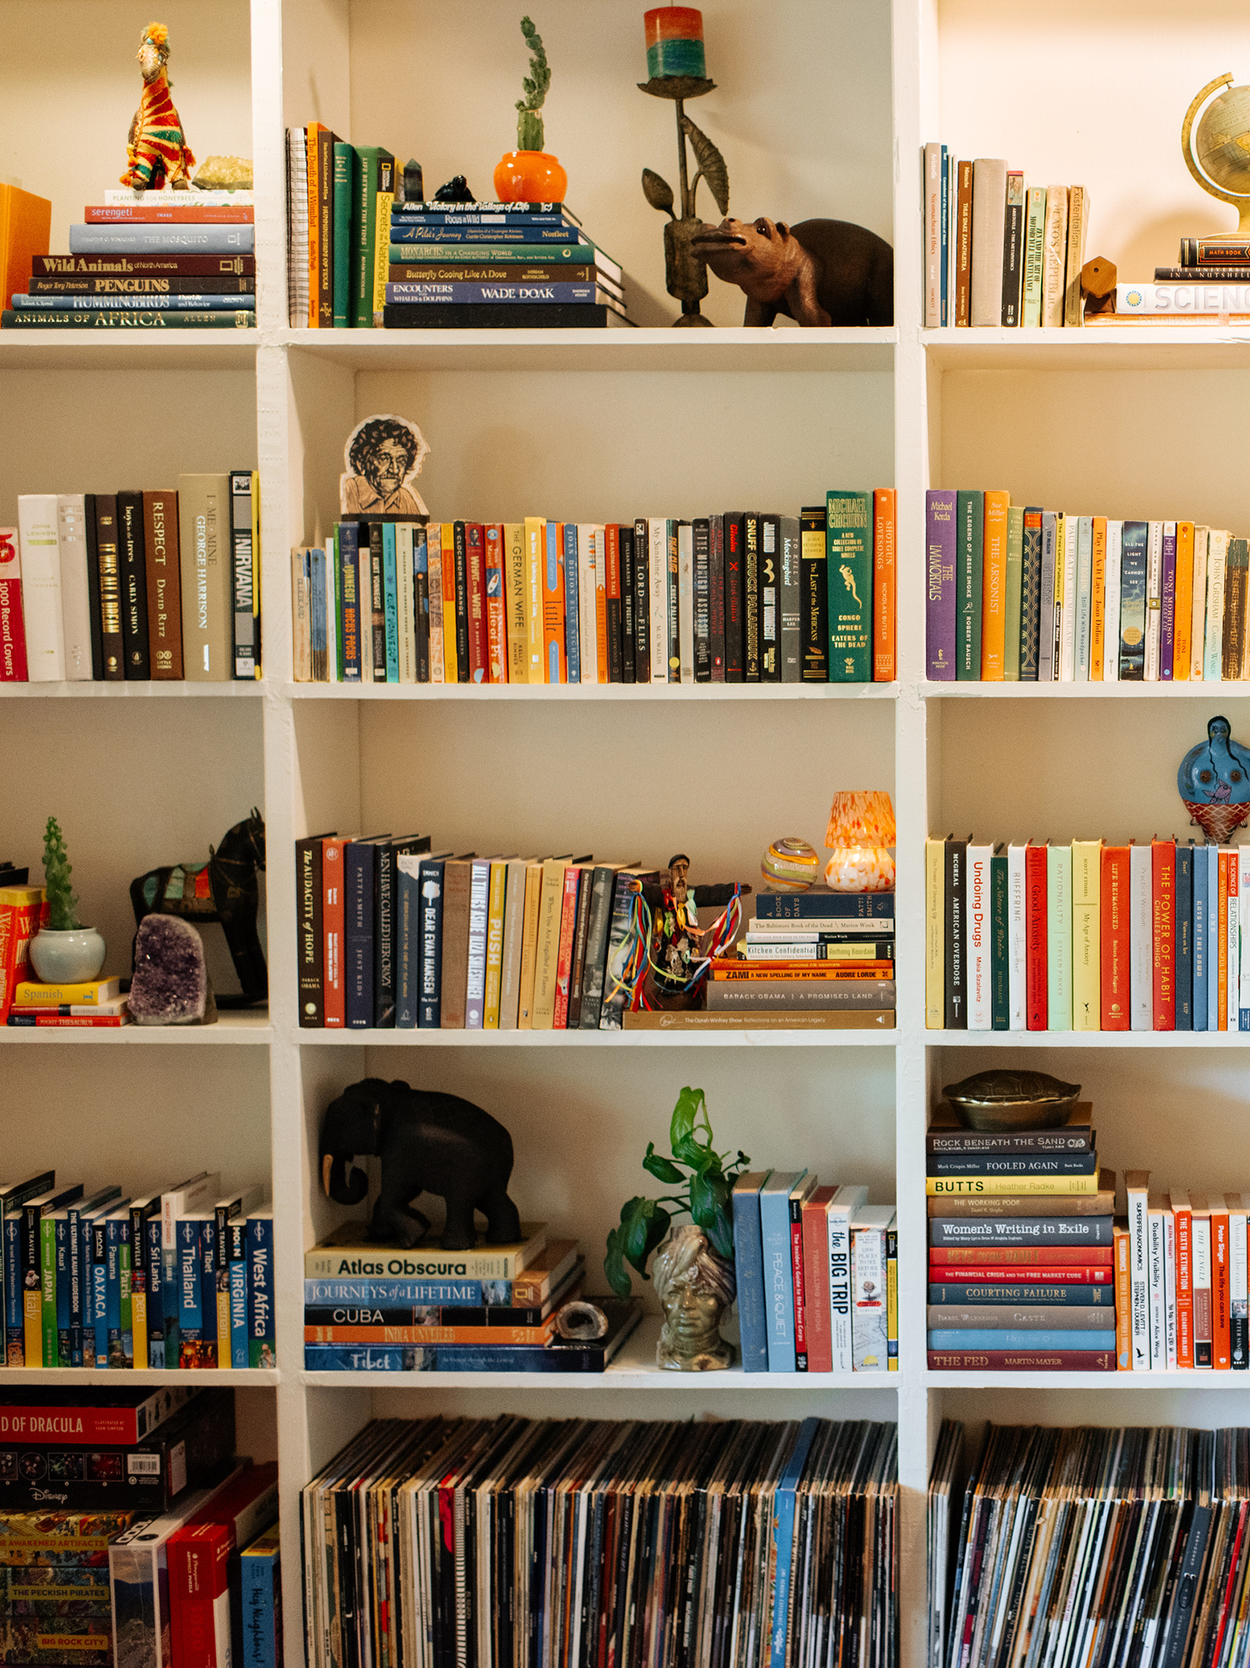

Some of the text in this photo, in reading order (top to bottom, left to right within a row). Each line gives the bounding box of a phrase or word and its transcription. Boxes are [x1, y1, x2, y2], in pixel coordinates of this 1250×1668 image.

[309, 176, 316, 187] of
[92, 208, 133, 217] serengeti
[43, 259, 133, 271] Wild Animals
[95, 280, 169, 292] PENGUINS
[481, 289, 554, 298] WADE DOAK
[15, 312, 166, 326] ANIMALS OF AFRICA
[153, 502, 166, 565] RESPECT
[967, 543, 972, 552] OF
[196, 516, 207, 629] GEORGE HARRISON
[236, 540, 252, 608] NIRVANA
[0, 581, 14, 676] 1000 Record Covers
[345, 608, 356, 660] HOCUS POCUS
[972, 862, 983, 947] Undoing Drugs
[303, 866, 314, 963] AUDACITY of HOPE
[1161, 866, 1170, 1002] THE POWER OF HABIT
[489, 920, 500, 965] PUSH
[24, 990, 63, 999] Spanish
[987, 1162, 1058, 1170] FOOLED AGAIN
[935, 1182, 984, 1191] BUTTS
[942, 1224, 1089, 1235] Women's Writing in Exile
[338, 1260, 384, 1276] Atlas
[388, 1260, 467, 1276] Obscura
[831, 1232, 848, 1314] the BIG TRIP
[182, 1246, 197, 1308] Thailand
[95, 1267, 106, 1319] OAXACA
[231, 1264, 244, 1328] VIRGINIA
[253, 1249, 269, 1337] West Africa
[312, 1286, 475, 1301] JOURNEYS LIFETIME
[333, 1310, 384, 1323] CUBA
[12, 1418, 26, 1432] OF
[30, 1418, 83, 1433] DRACULA
[29, 1488, 68, 1504] Disney
